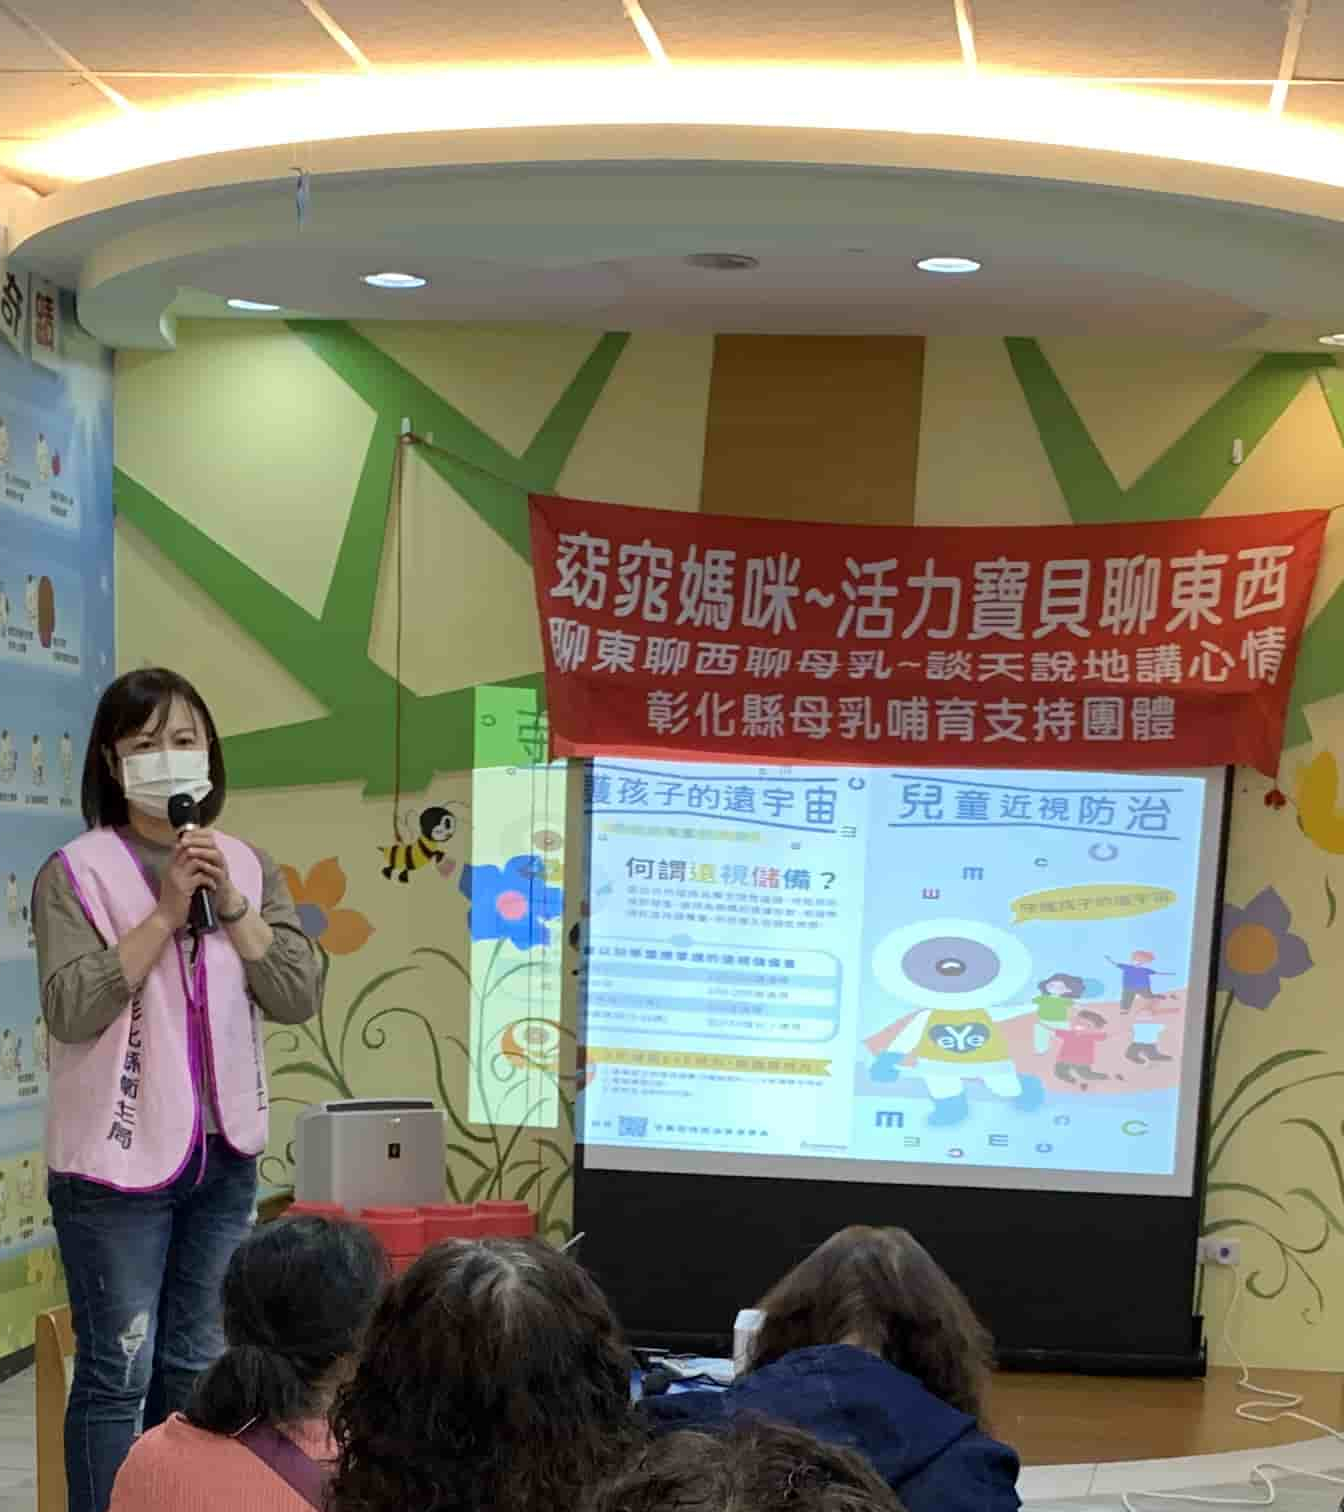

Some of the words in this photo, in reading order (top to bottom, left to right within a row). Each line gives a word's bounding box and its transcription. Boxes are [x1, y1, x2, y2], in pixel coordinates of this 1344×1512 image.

[645, 690, 1178, 743] 彰化縣母乳哺育支持團體
[898, 783, 1172, 832] 兒童近視防治
